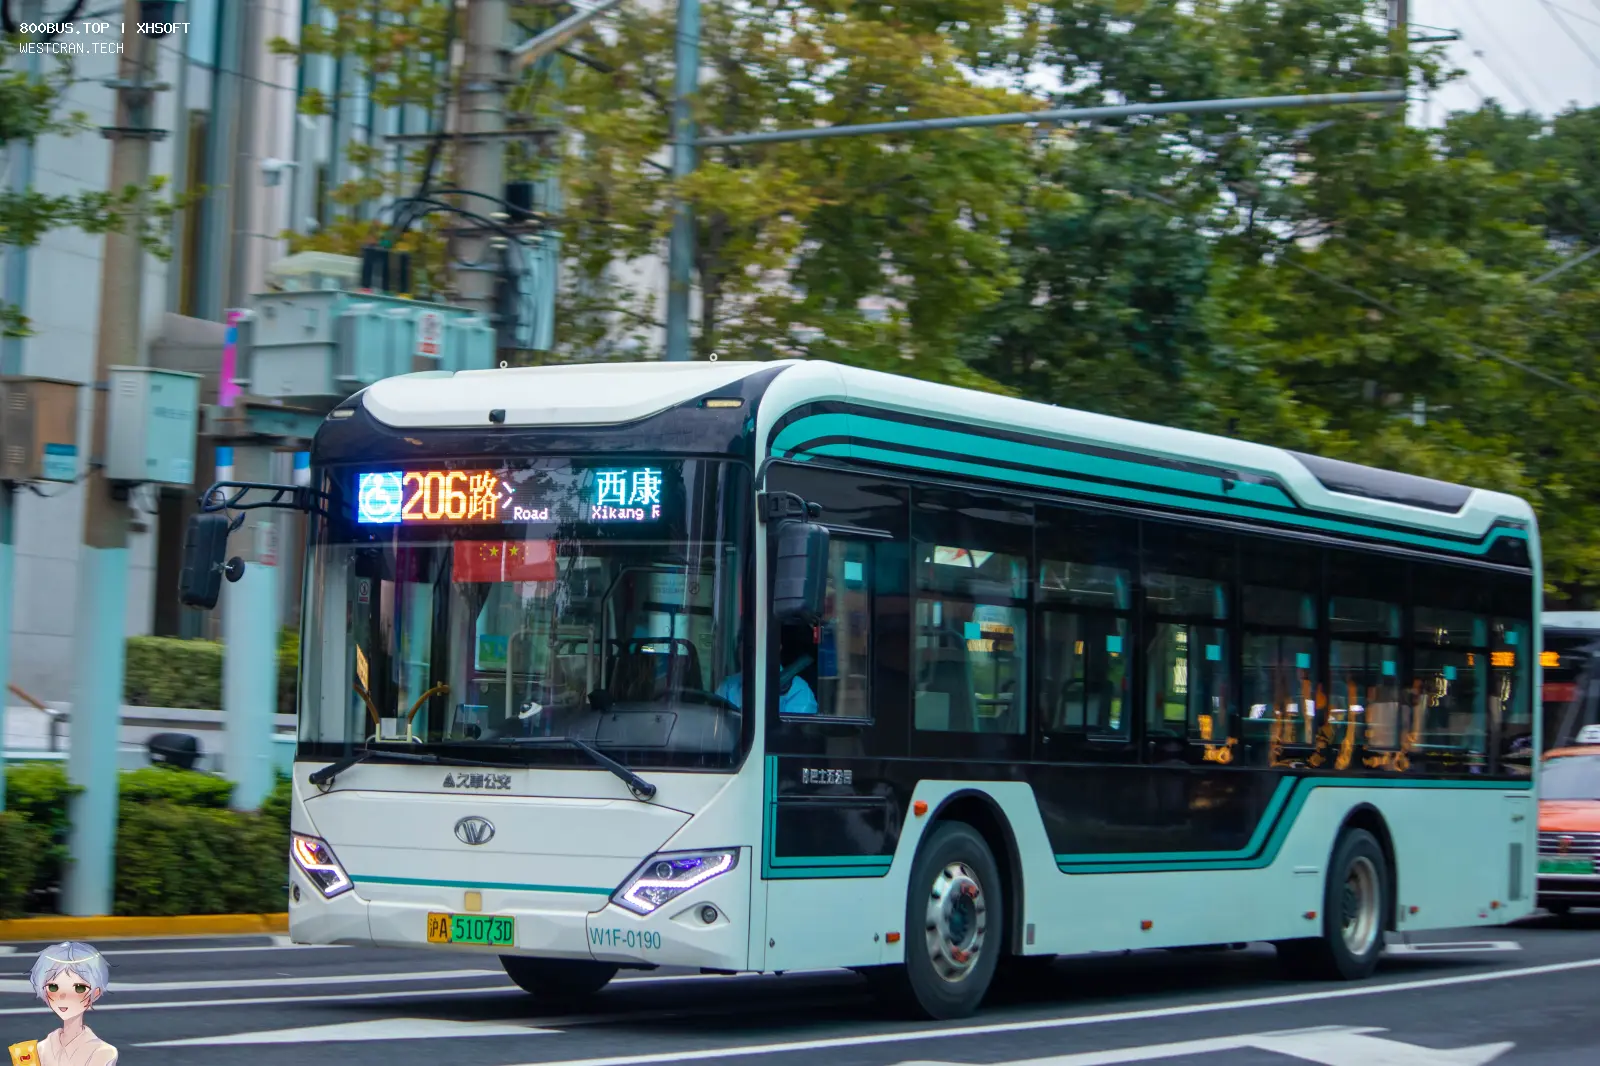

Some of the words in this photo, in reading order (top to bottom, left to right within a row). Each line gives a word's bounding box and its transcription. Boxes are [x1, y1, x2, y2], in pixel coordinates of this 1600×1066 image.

[401, 471, 498, 520] 206路
[596, 468, 662, 506] 西康
[513, 506, 549, 521] Road
[592, 505, 644, 521] Xikang
[455, 918, 512, 941] 51073D
[589, 927, 661, 950] W1F-0190
